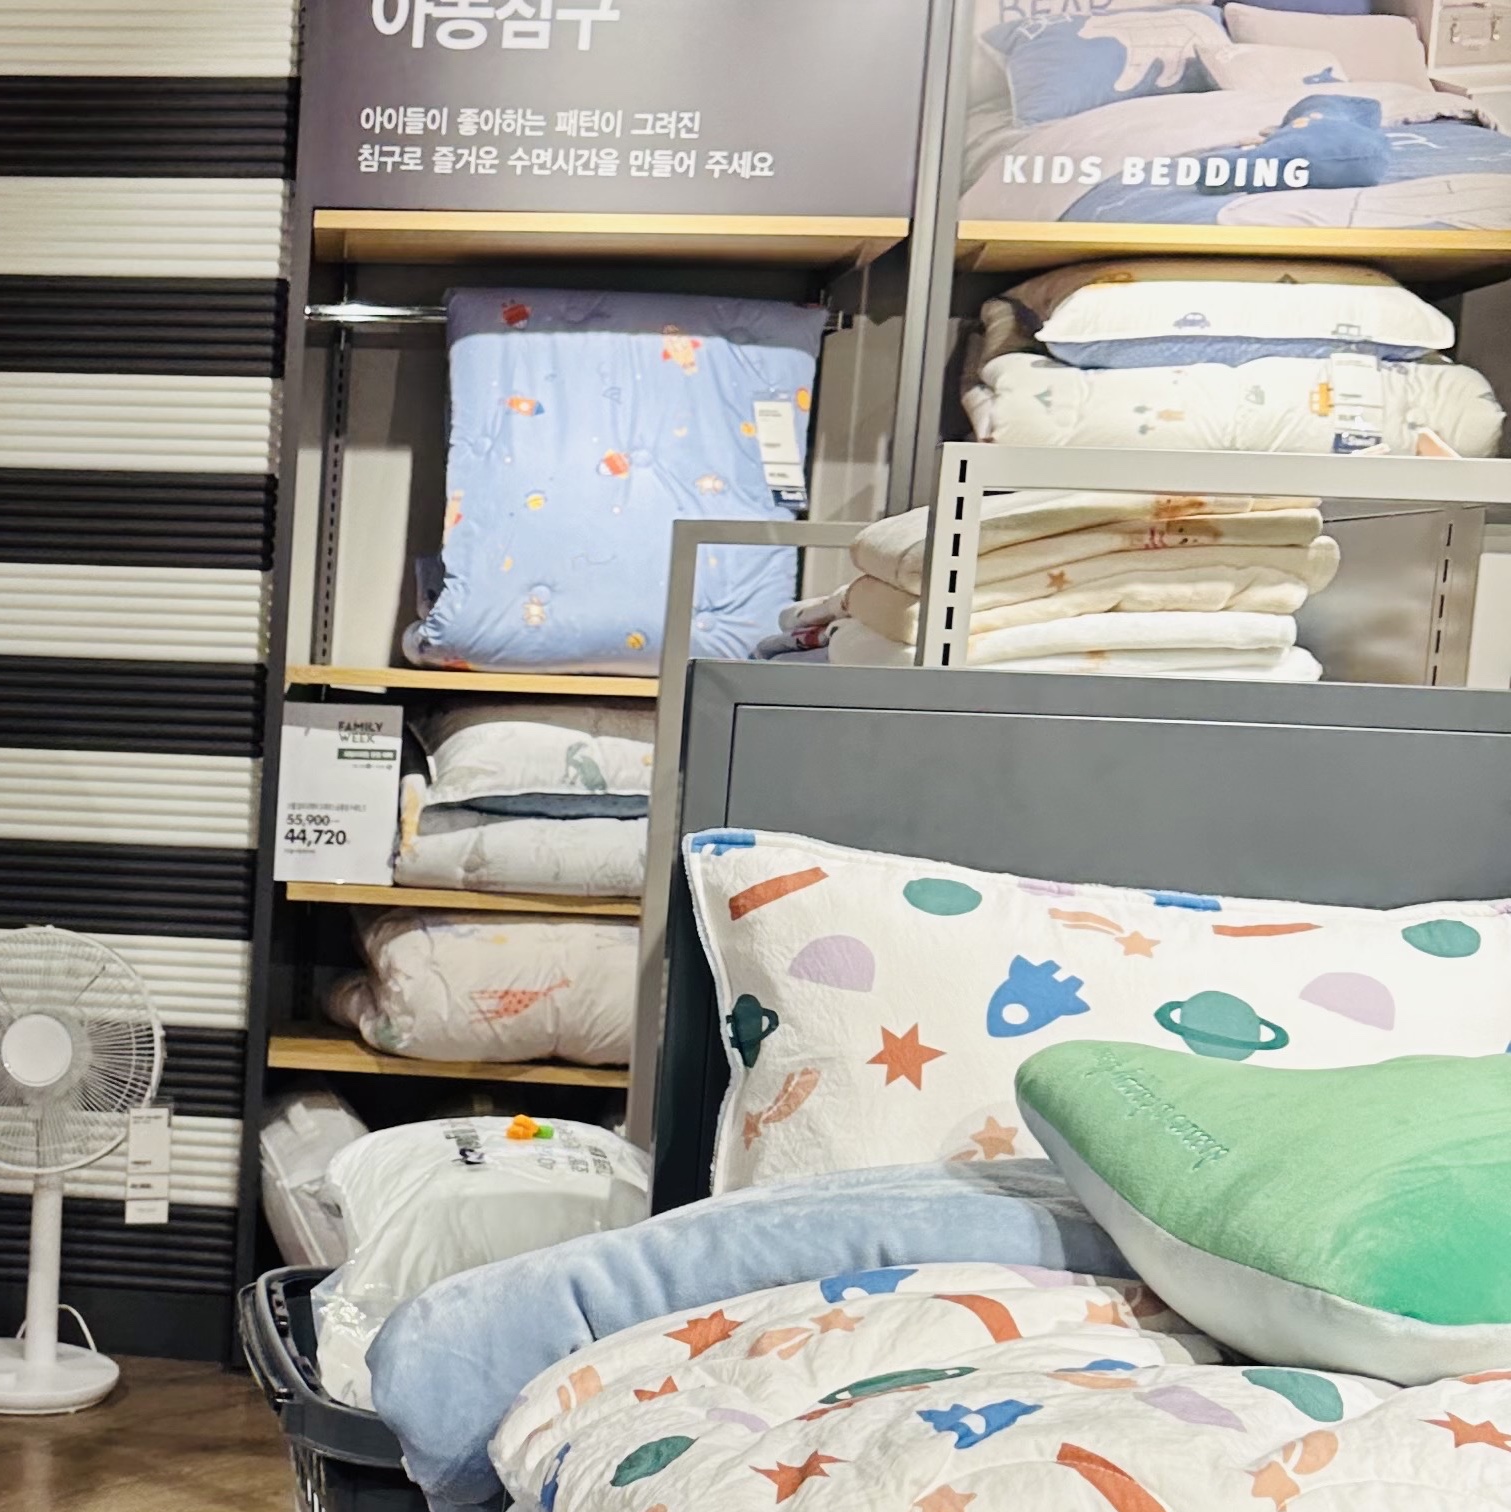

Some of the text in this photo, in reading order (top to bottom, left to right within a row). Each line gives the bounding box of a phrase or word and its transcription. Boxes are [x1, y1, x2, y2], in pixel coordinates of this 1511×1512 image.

[359, 107, 702, 139] 아이들이 좋아하는 패턴이 그려진
[357, 144, 776, 180] 침구로 즐거운 수면시간을 만들어 주세요
[1002, 154, 1311, 189] KIDS BEDDING
[338, 720, 384, 733] FAMILY
[339, 732, 376, 744] WEEK
[286, 813, 331, 827] 55,900
[284, 828, 347, 847] 44,720
